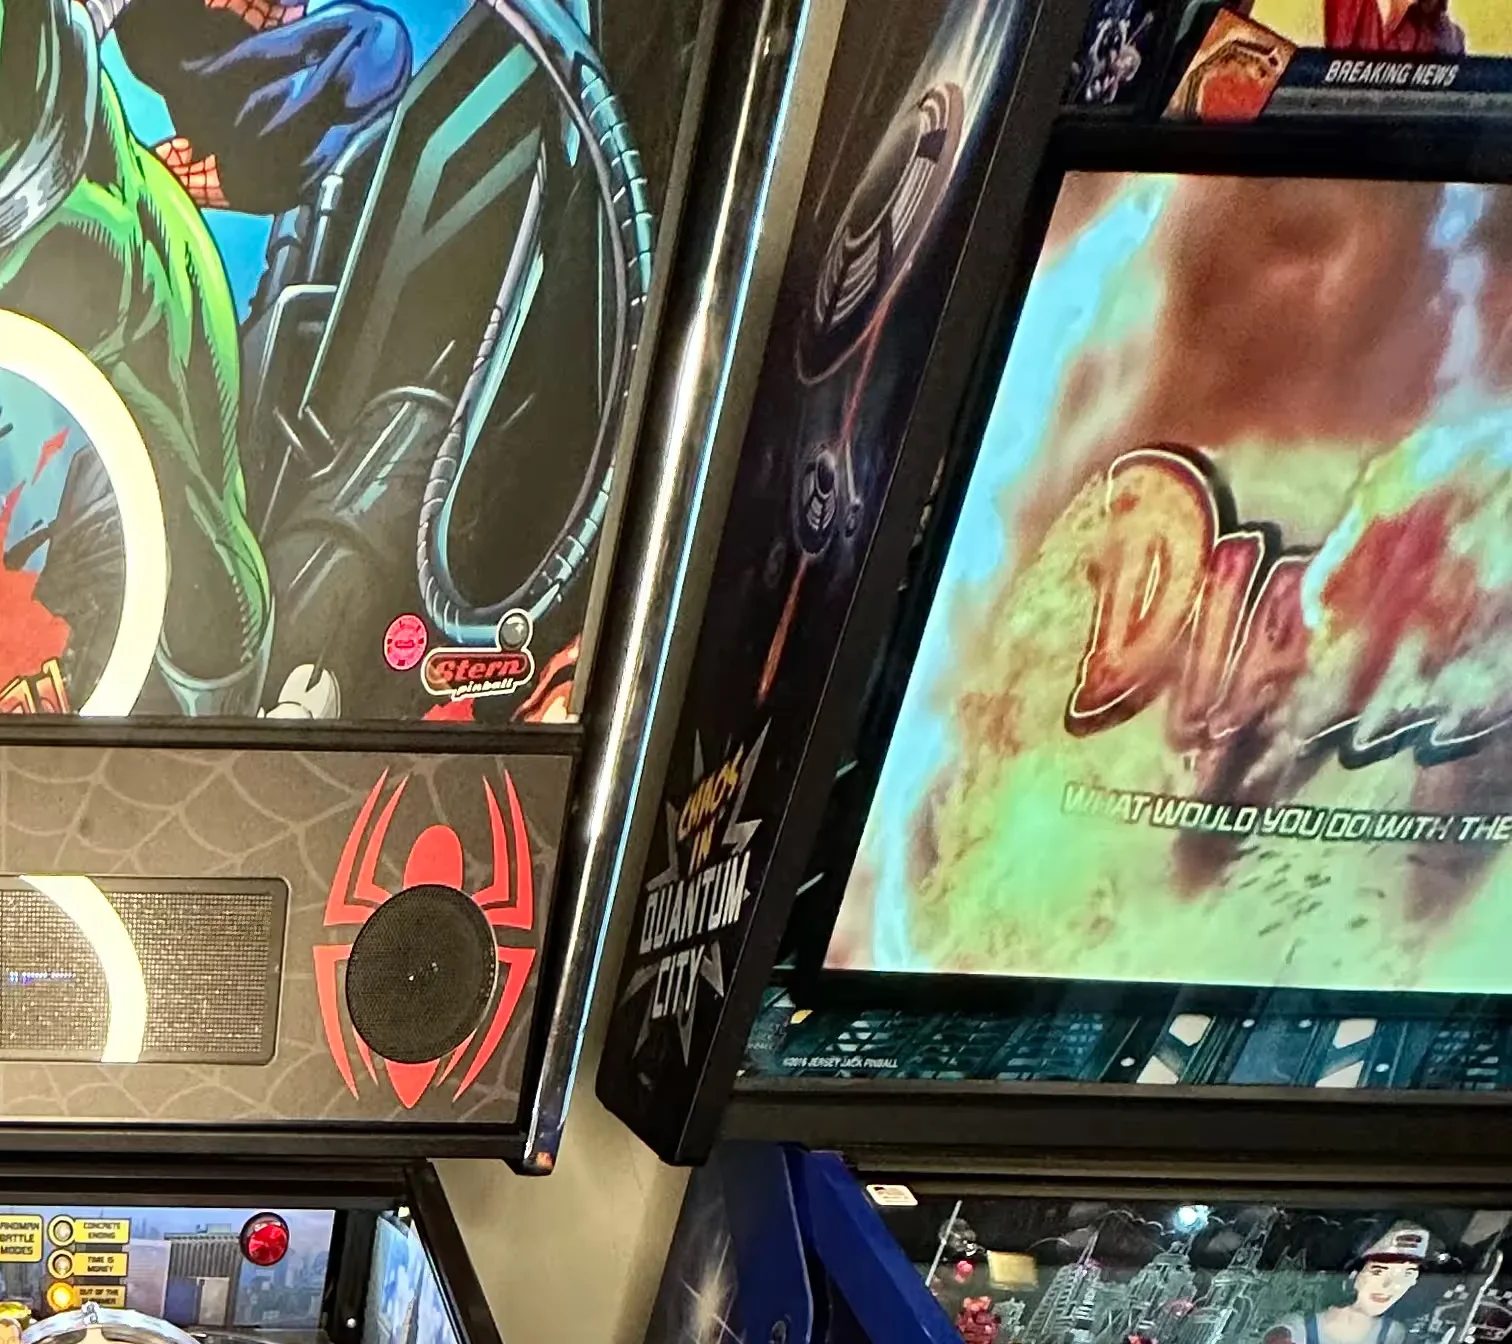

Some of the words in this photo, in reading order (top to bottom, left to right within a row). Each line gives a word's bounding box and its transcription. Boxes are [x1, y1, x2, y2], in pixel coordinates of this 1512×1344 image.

[1324, 59, 1406, 86] BREAKING
[1411, 62, 1459, 87] NEWS
[432, 657, 521, 682] Stern
[457, 678, 513, 695] pinball
[1065, 783, 1151, 820] WHAT
[1153, 799, 1255, 831] WOULD
[1262, 806, 1321, 836] YOU
[1326, 813, 1368, 838] DO
[1374, 816, 1452, 840] WITH
[1458, 816, 1511, 840] THE
[640, 851, 750, 951] QUANTUM
[652, 944, 705, 1020] CITY
[808, 1057, 840, 1068] JERSEY
[841, 1058, 863, 1068] JACK
[864, 1058, 899, 1069] PINBALL
